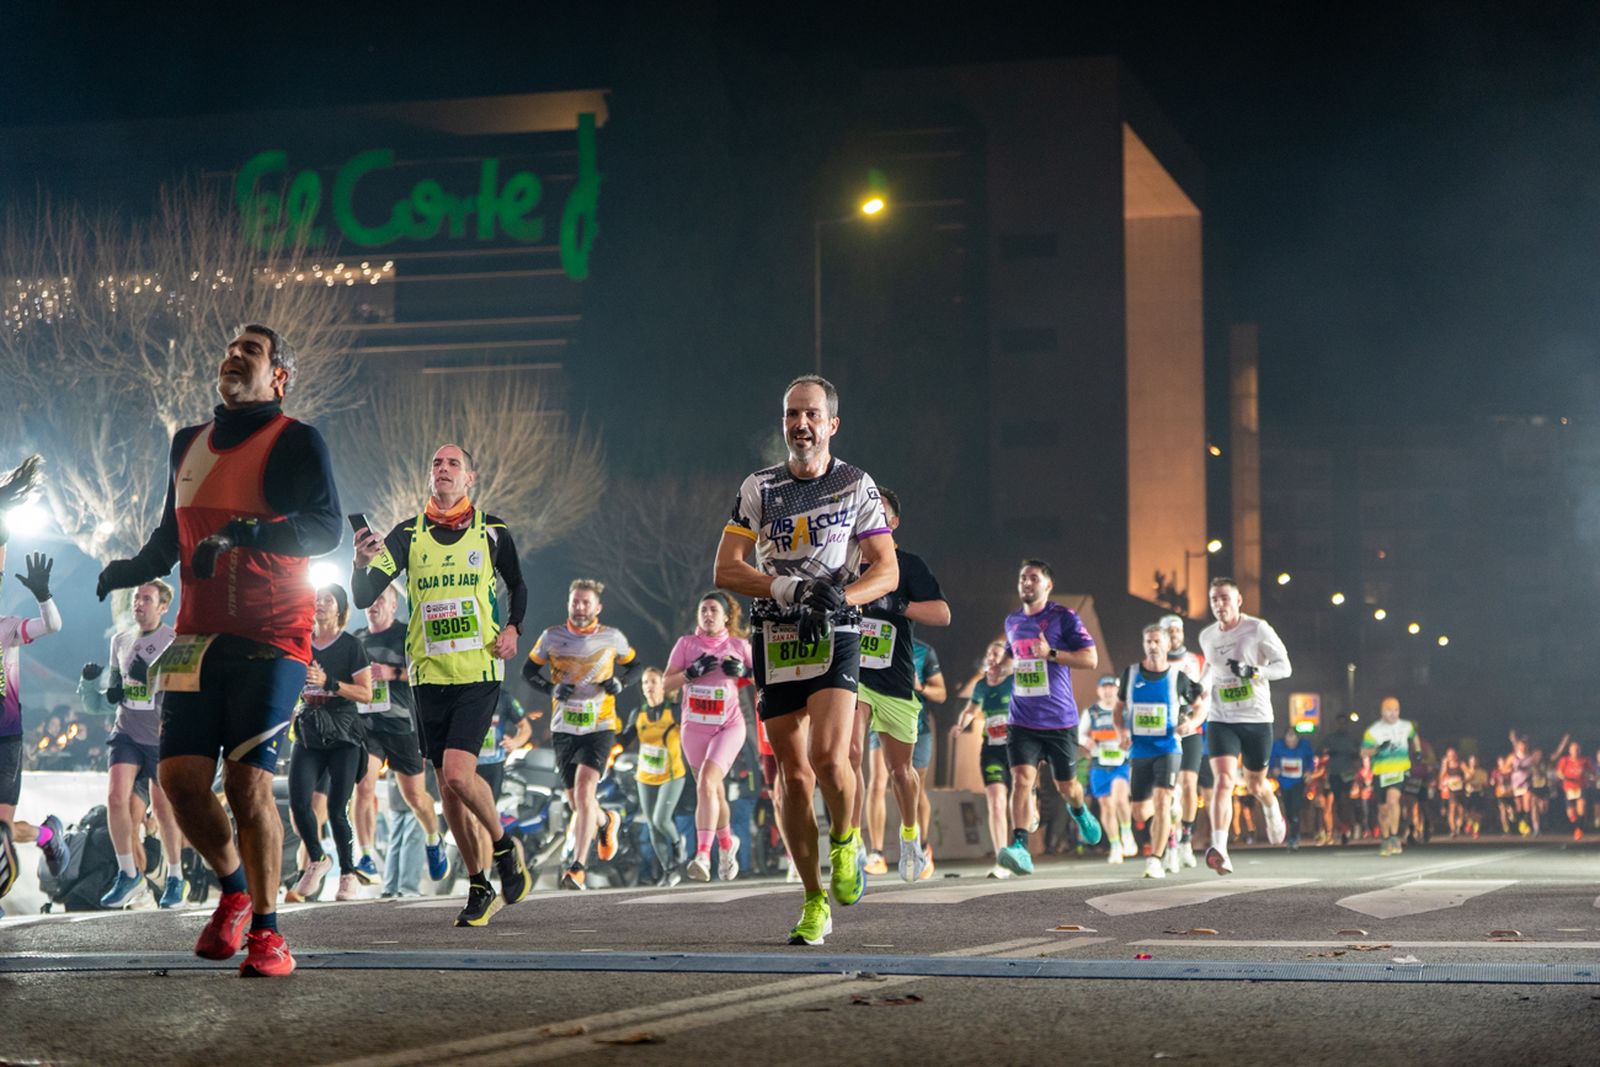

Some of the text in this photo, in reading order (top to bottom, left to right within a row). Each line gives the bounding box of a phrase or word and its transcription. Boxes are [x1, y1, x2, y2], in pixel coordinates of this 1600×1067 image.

[334, 148, 545, 247] Corte
[417, 575, 439, 590] CAJA
[442, 574, 455, 587] DE
[431, 616, 471, 636] 9305
[772, 632, 786, 641] SAN
[780, 640, 819, 661] 8767
